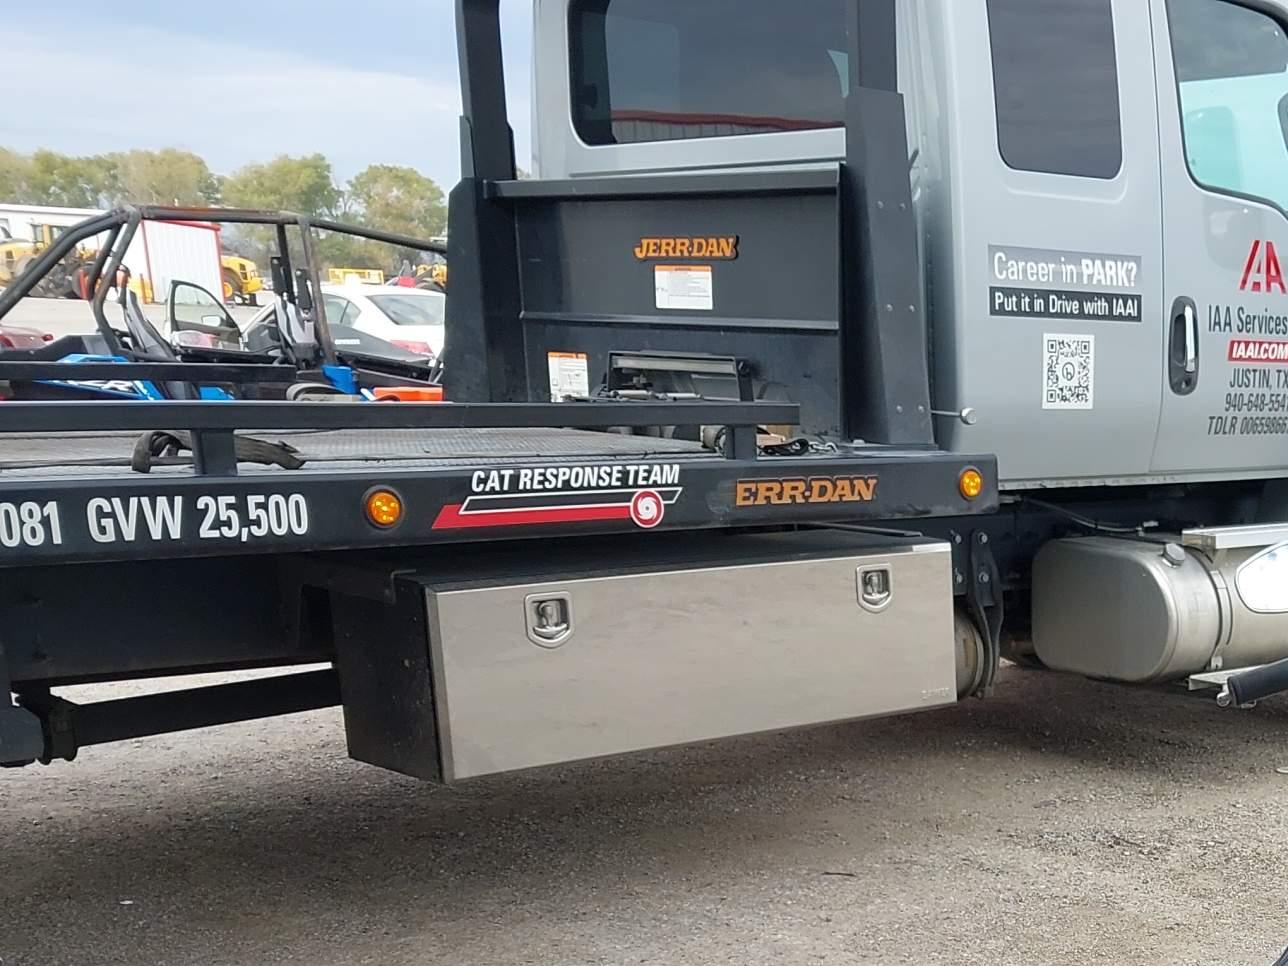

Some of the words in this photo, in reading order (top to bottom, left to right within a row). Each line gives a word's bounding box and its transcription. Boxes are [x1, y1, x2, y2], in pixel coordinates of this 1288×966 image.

[994, 251, 1055, 282] Career
[1061, 256, 1077, 284] in
[1081, 258, 1138, 288] PARK?
[995, 291, 1018, 313] Put
[1021, 292, 1031, 313] it
[1034, 294, 1045, 314] in
[1049, 294, 1080, 316] Drive
[1083, 296, 1109, 317] with
[1112, 297, 1139, 318] IAAI
[1208, 304, 1233, 333] IAA
[1229, 367, 1273, 390] JUSTIN,
[1207, 415, 1239, 435] TDLR
[471, 469, 515, 492] CAT
[518, 465, 625, 490] RESPONSE
[626, 464, 680, 486] TEAM
[0, 500, 63, 548] 081
[86, 495, 184, 544] GVW
[196, 493, 310, 543] 25,500
